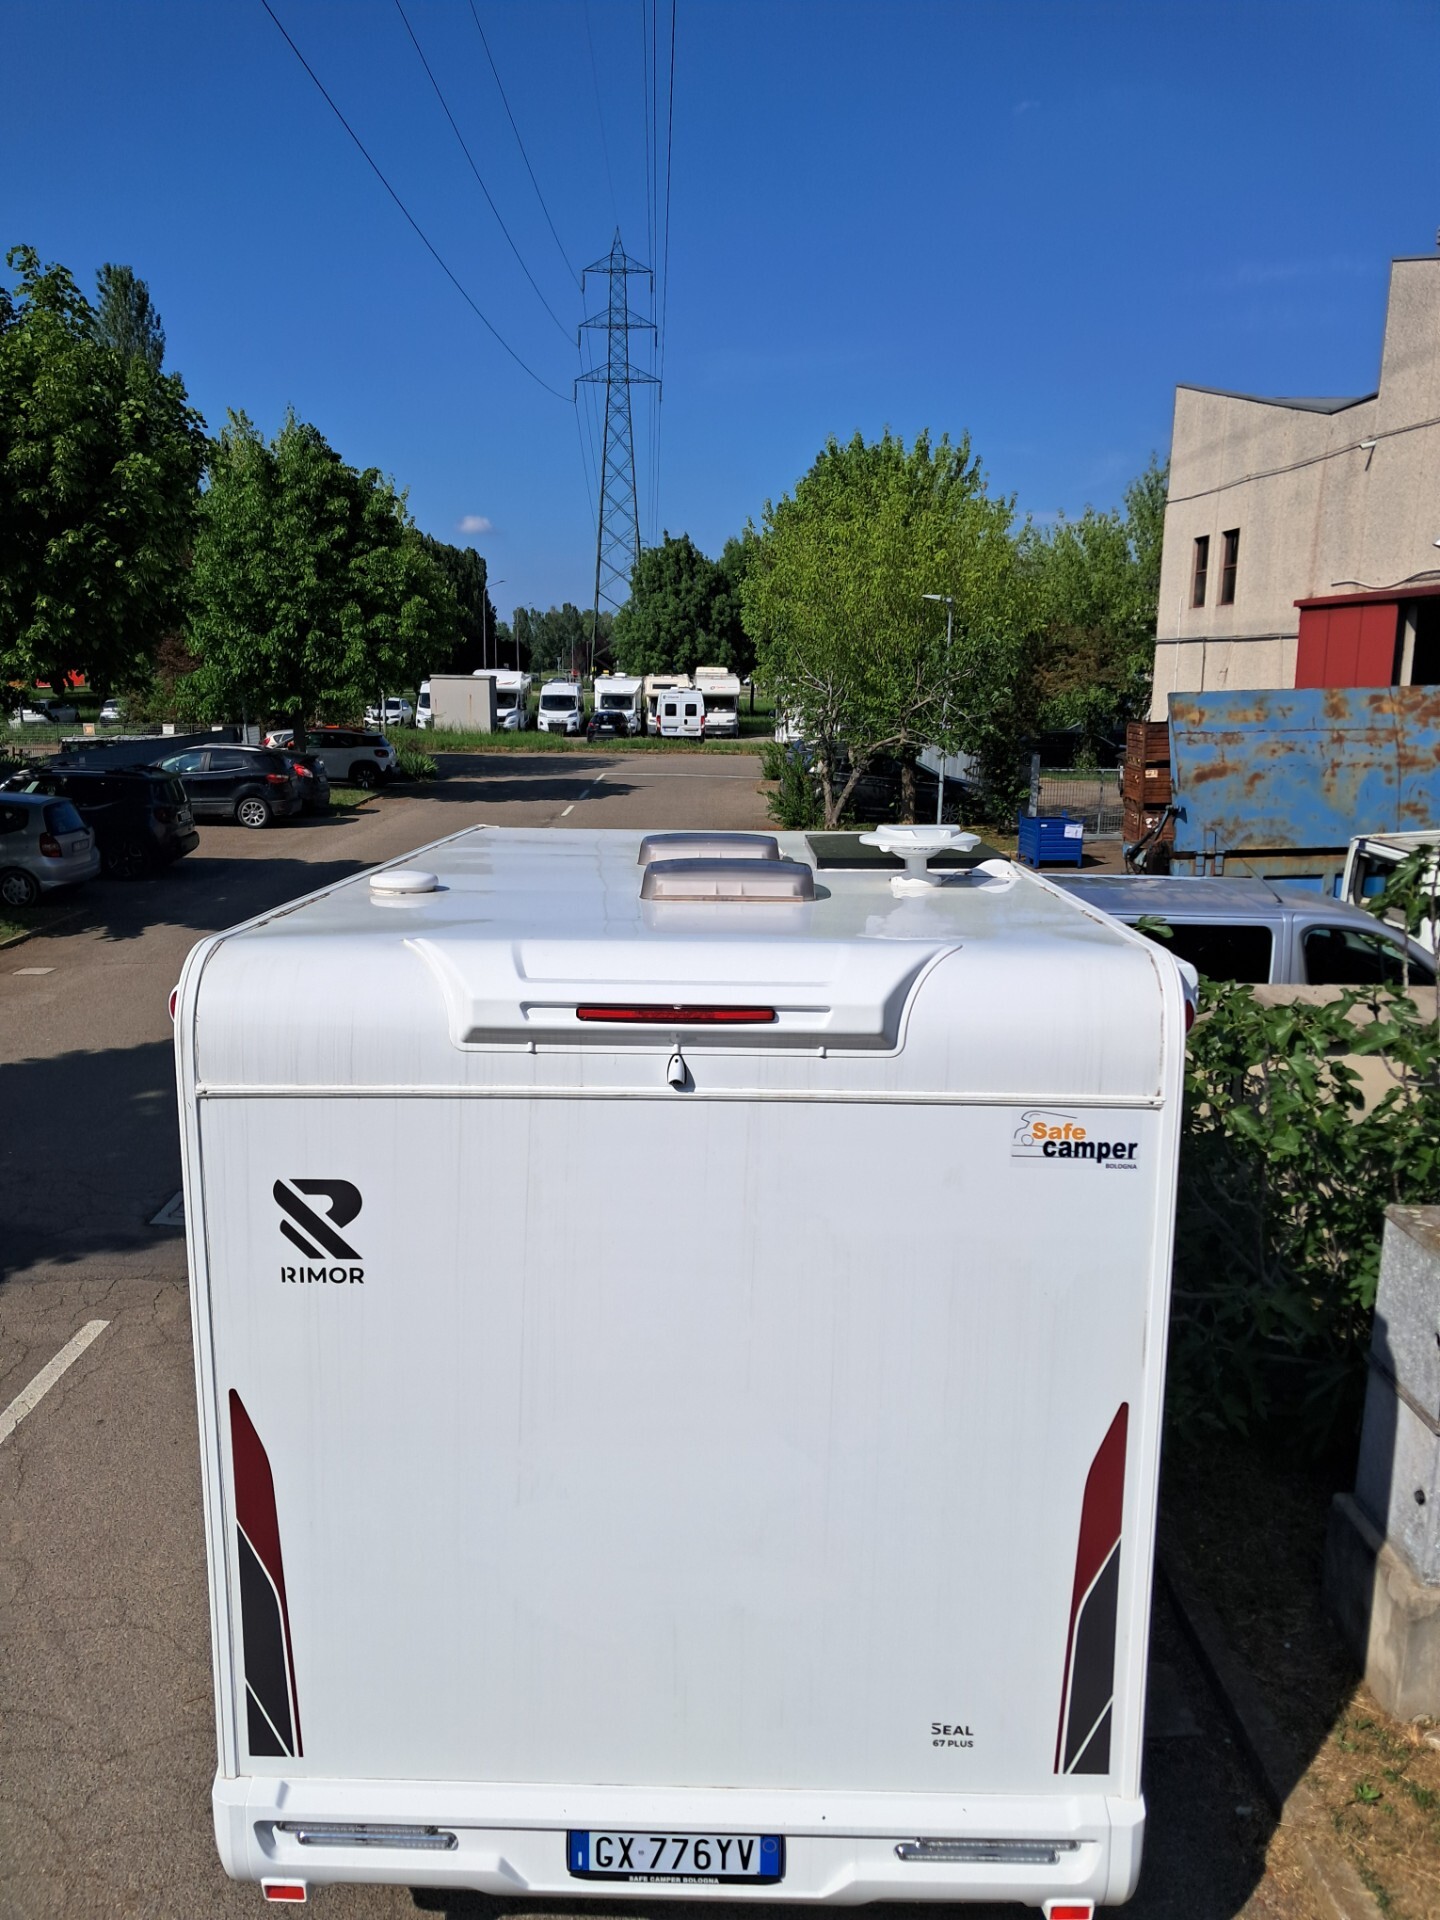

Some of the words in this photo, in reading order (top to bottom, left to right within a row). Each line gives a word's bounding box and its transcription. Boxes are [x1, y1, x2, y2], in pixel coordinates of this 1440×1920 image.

[1032, 1122, 1087, 1140] Safe
[1043, 1140, 1138, 1164] camper
[281, 1267, 365, 1284] RIMOR
[932, 1739, 946, 1747] 67
[947, 1740, 974, 1748] PLUS
[595, 1836, 635, 1869] GX
[649, 1837, 755, 1871] 776YV
